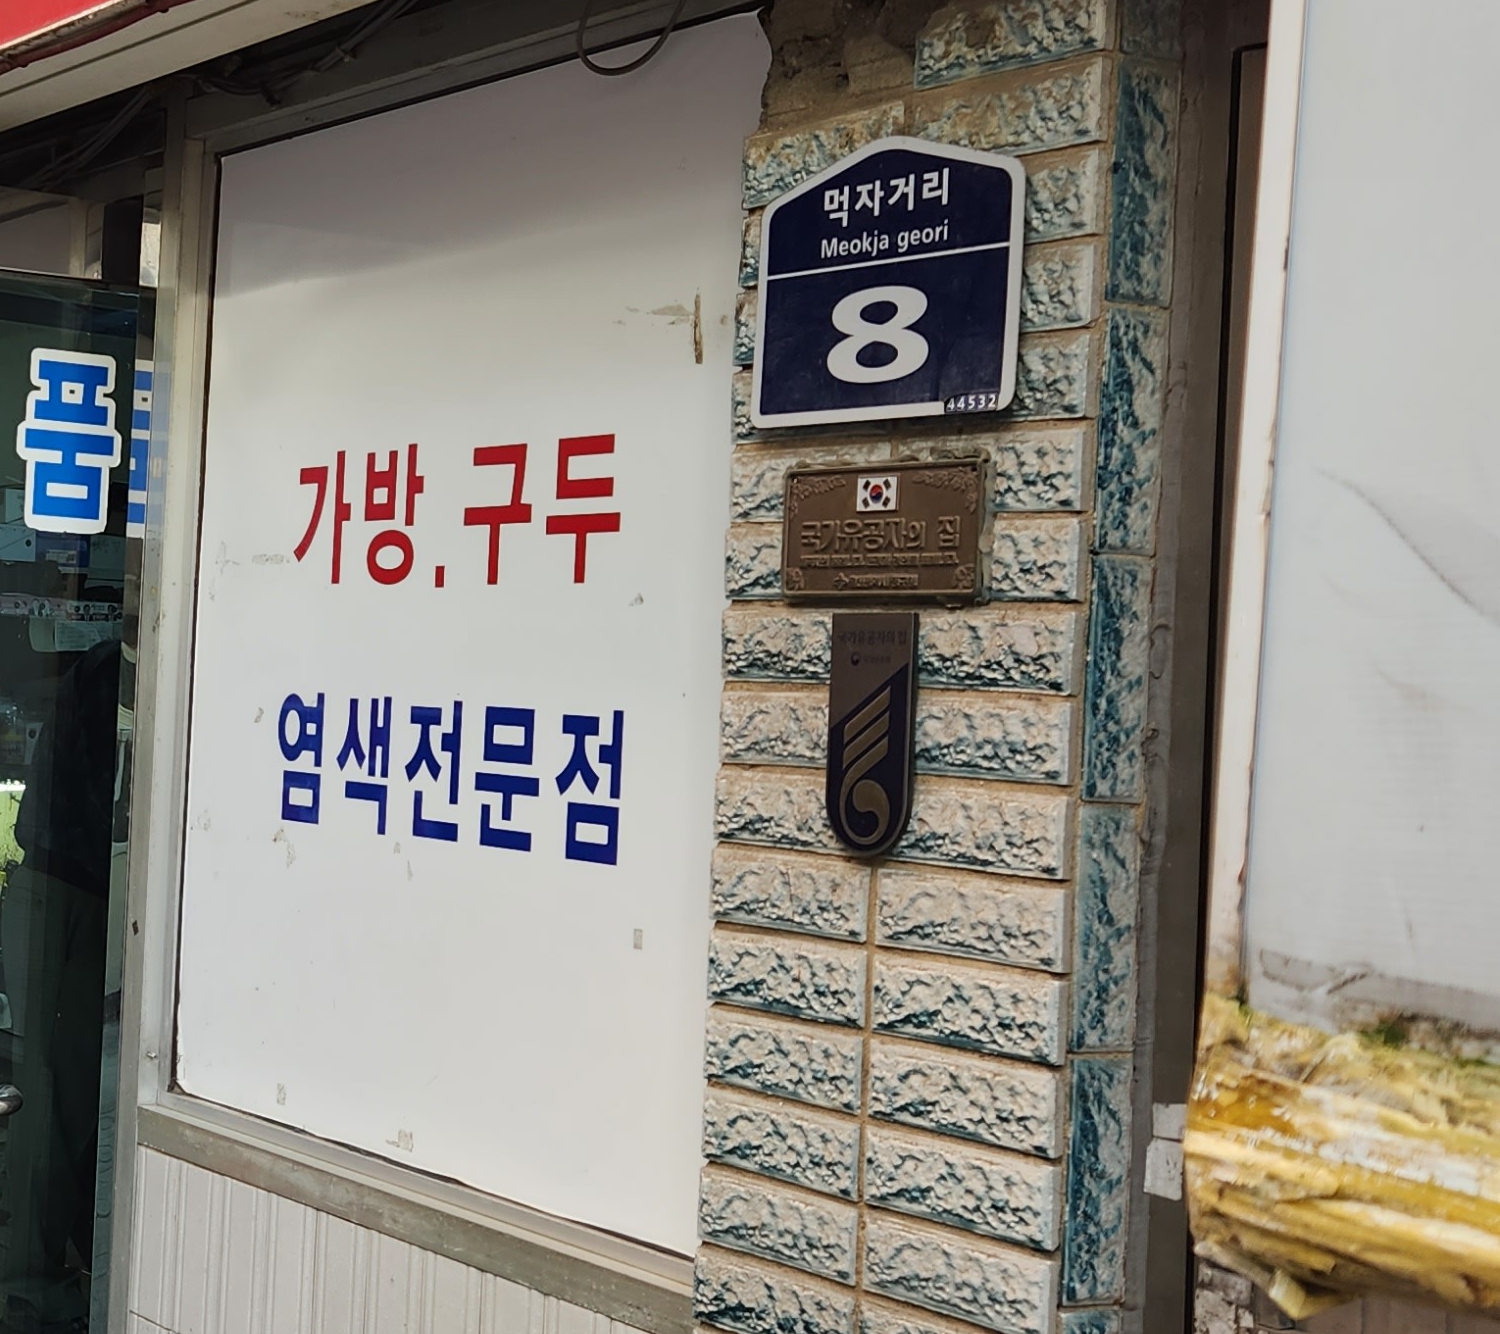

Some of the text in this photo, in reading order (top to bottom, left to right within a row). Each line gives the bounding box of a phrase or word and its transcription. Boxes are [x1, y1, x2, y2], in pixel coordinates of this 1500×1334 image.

[823, 167, 950, 228] 먹자거리
[820, 218, 949, 259] Meokja geori
[826, 284, 930, 384] 8
[947, 393, 997, 411] 44532
[800, 515, 962, 552] 국가유공자의 집
[277, 690, 625, 867] 염색전문점
